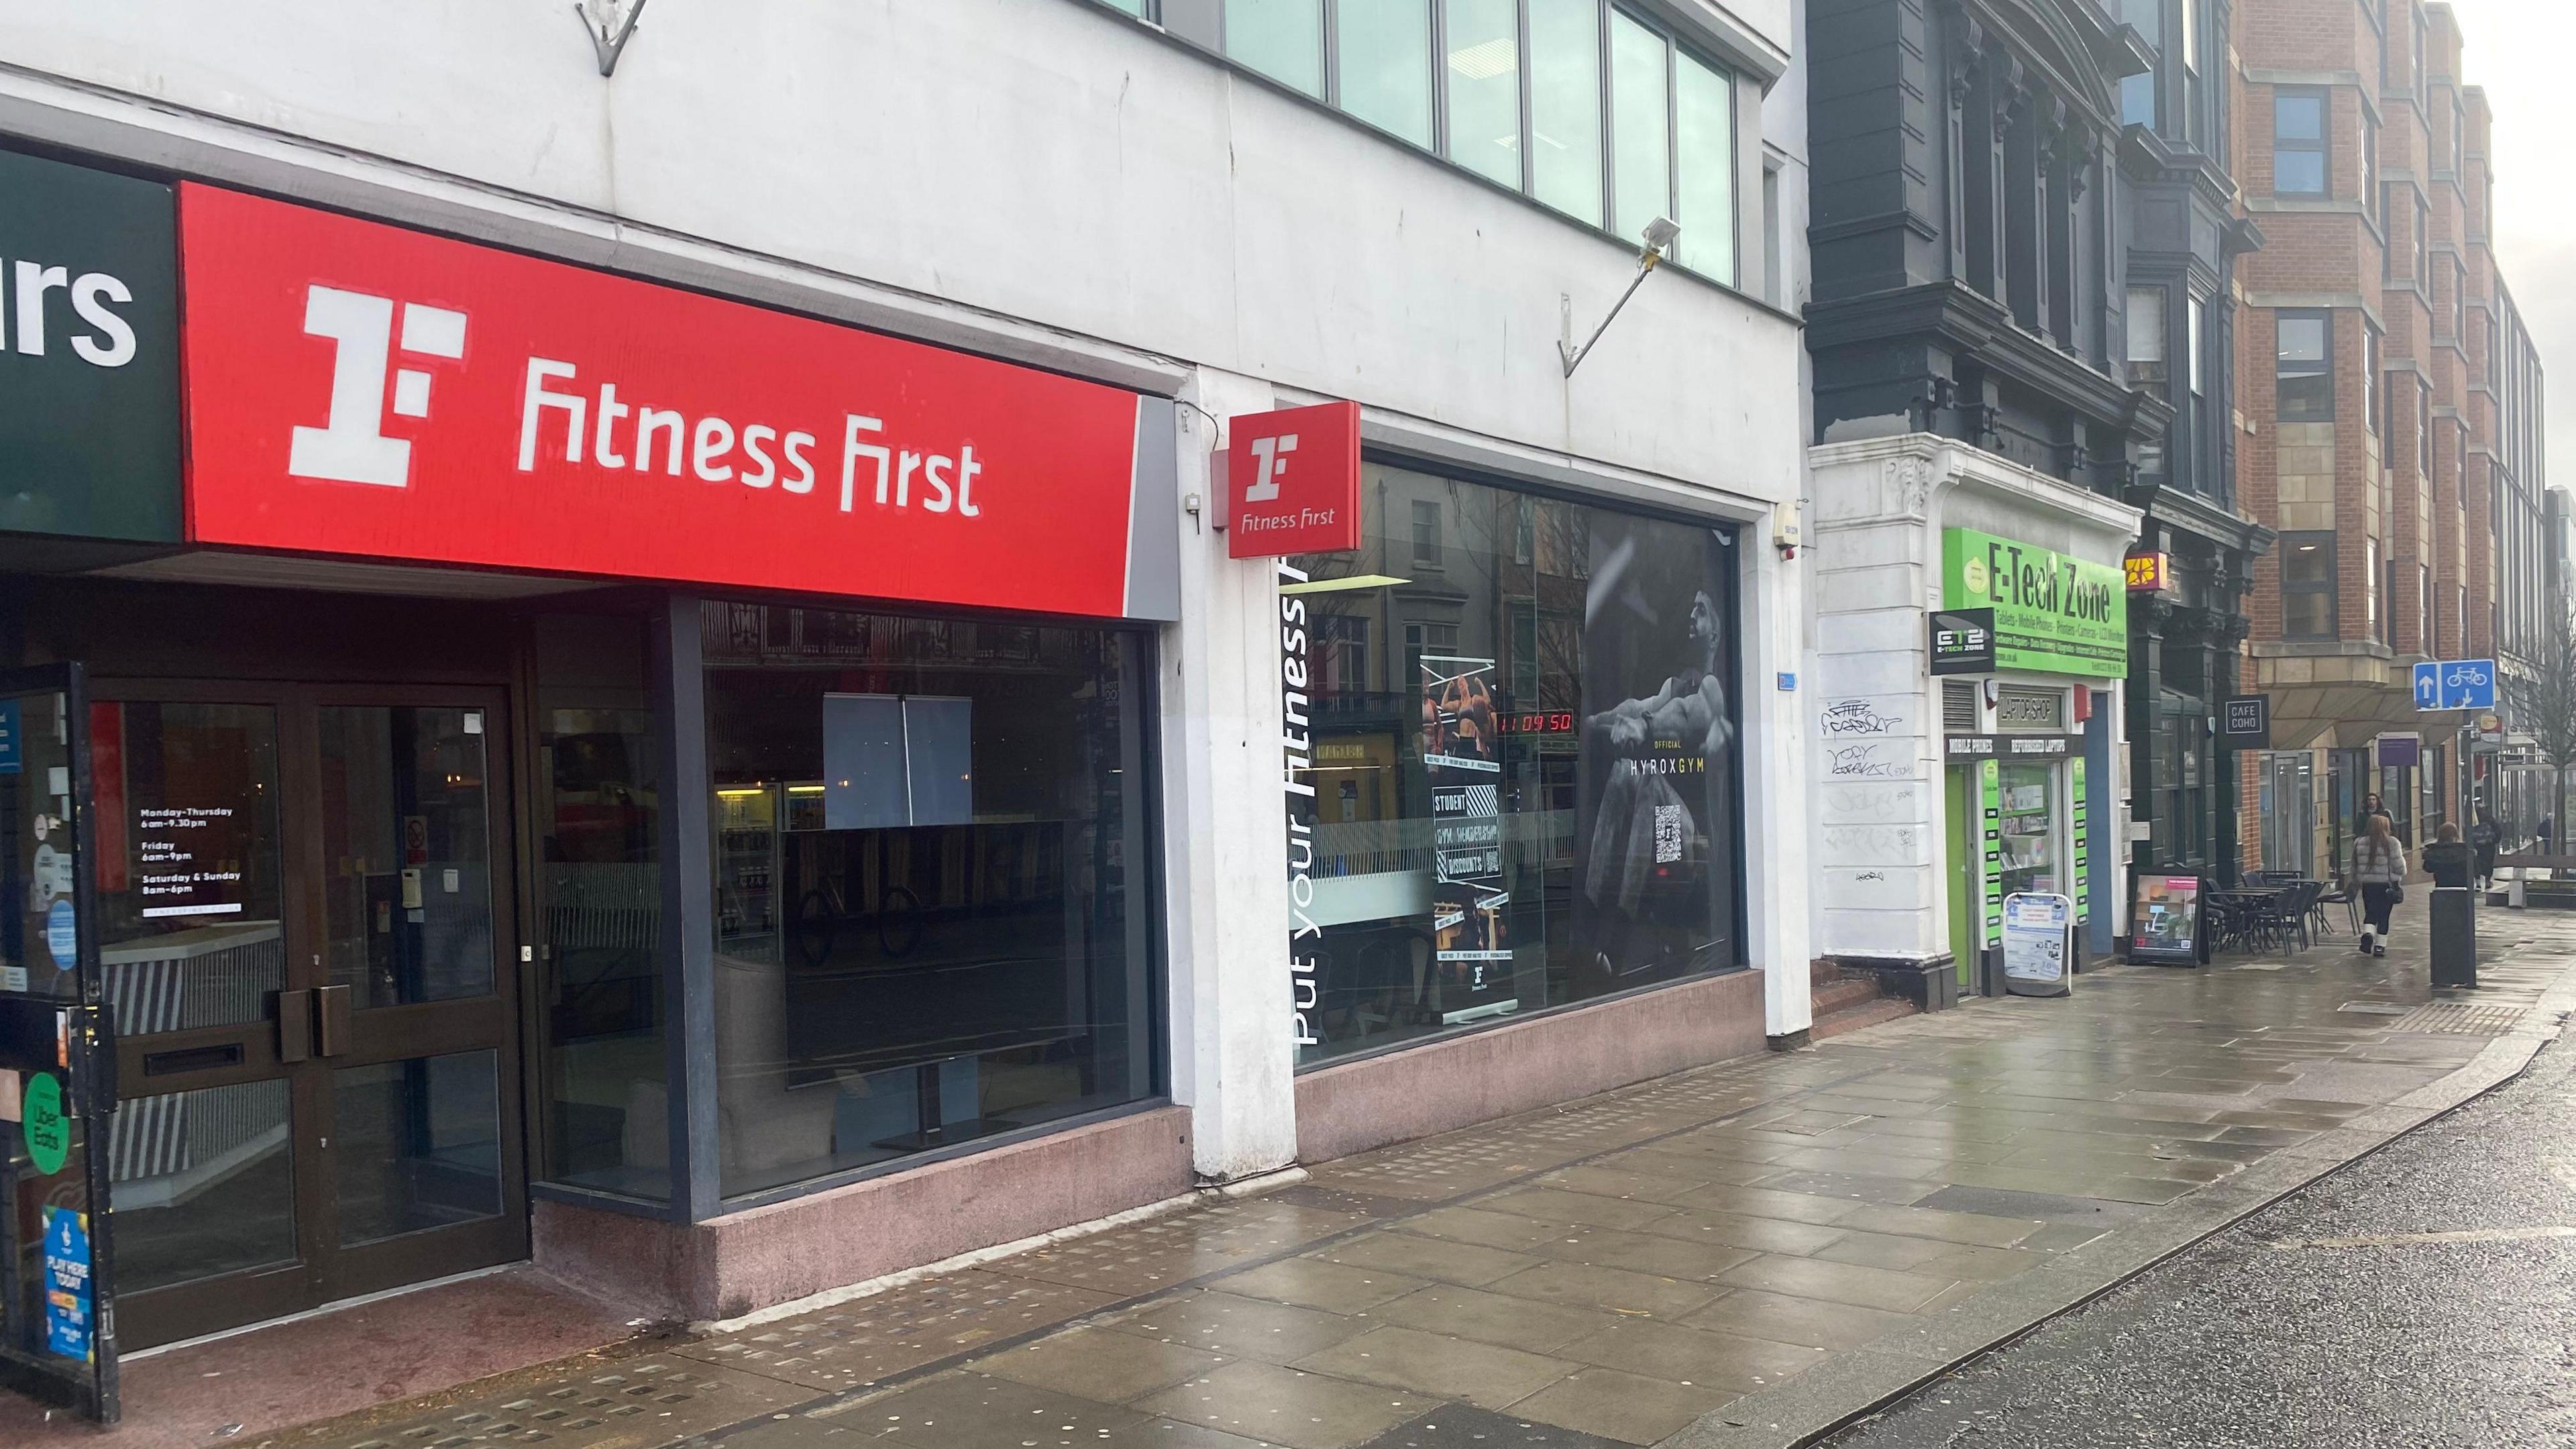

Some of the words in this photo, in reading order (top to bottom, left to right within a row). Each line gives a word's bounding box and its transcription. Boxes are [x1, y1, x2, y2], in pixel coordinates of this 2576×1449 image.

[0, 257, 137, 368] rs
[518, 356, 816, 494] Fitness
[840, 413, 983, 517] First
[1242, 514, 1296, 534] Fitness
[1301, 508, 1335, 529] First
[1989, 542, 2057, 613] E-Tech
[2063, 562, 2110, 624] Zone
[2002, 697, 2030, 721] LAPTOP
[2031, 698, 2051, 721] SHOP
[2232, 706, 2255, 716] CAFE
[1550, 714, 1570, 730] 50
[2232, 717, 2255, 729] COHO
[1654, 741, 1682, 749] OFFICIAL
[1949, 739, 1971, 753] MOBILE
[1972, 739, 1992, 753] PHONES
[1435, 794, 1465, 812] STUDENT
[140, 808, 233, 817] Monday-Thursday
[1437, 826, 1452, 845] GYM
[1456, 824, 1497, 843] MEMBERSHIP
[142, 842, 175, 851] Friday
[142, 852, 193, 861] 6am-9pm
[1449, 857, 1482, 874] DISCOUNTS
[142, 874, 191, 883] Saturday
[193, 873, 201, 881] &
[203, 872, 241, 881] Sunday
[1290, 814, 1322, 939] your
[142, 885, 193, 894] 8am-6pm
[1291, 956, 1318, 1044] Put
